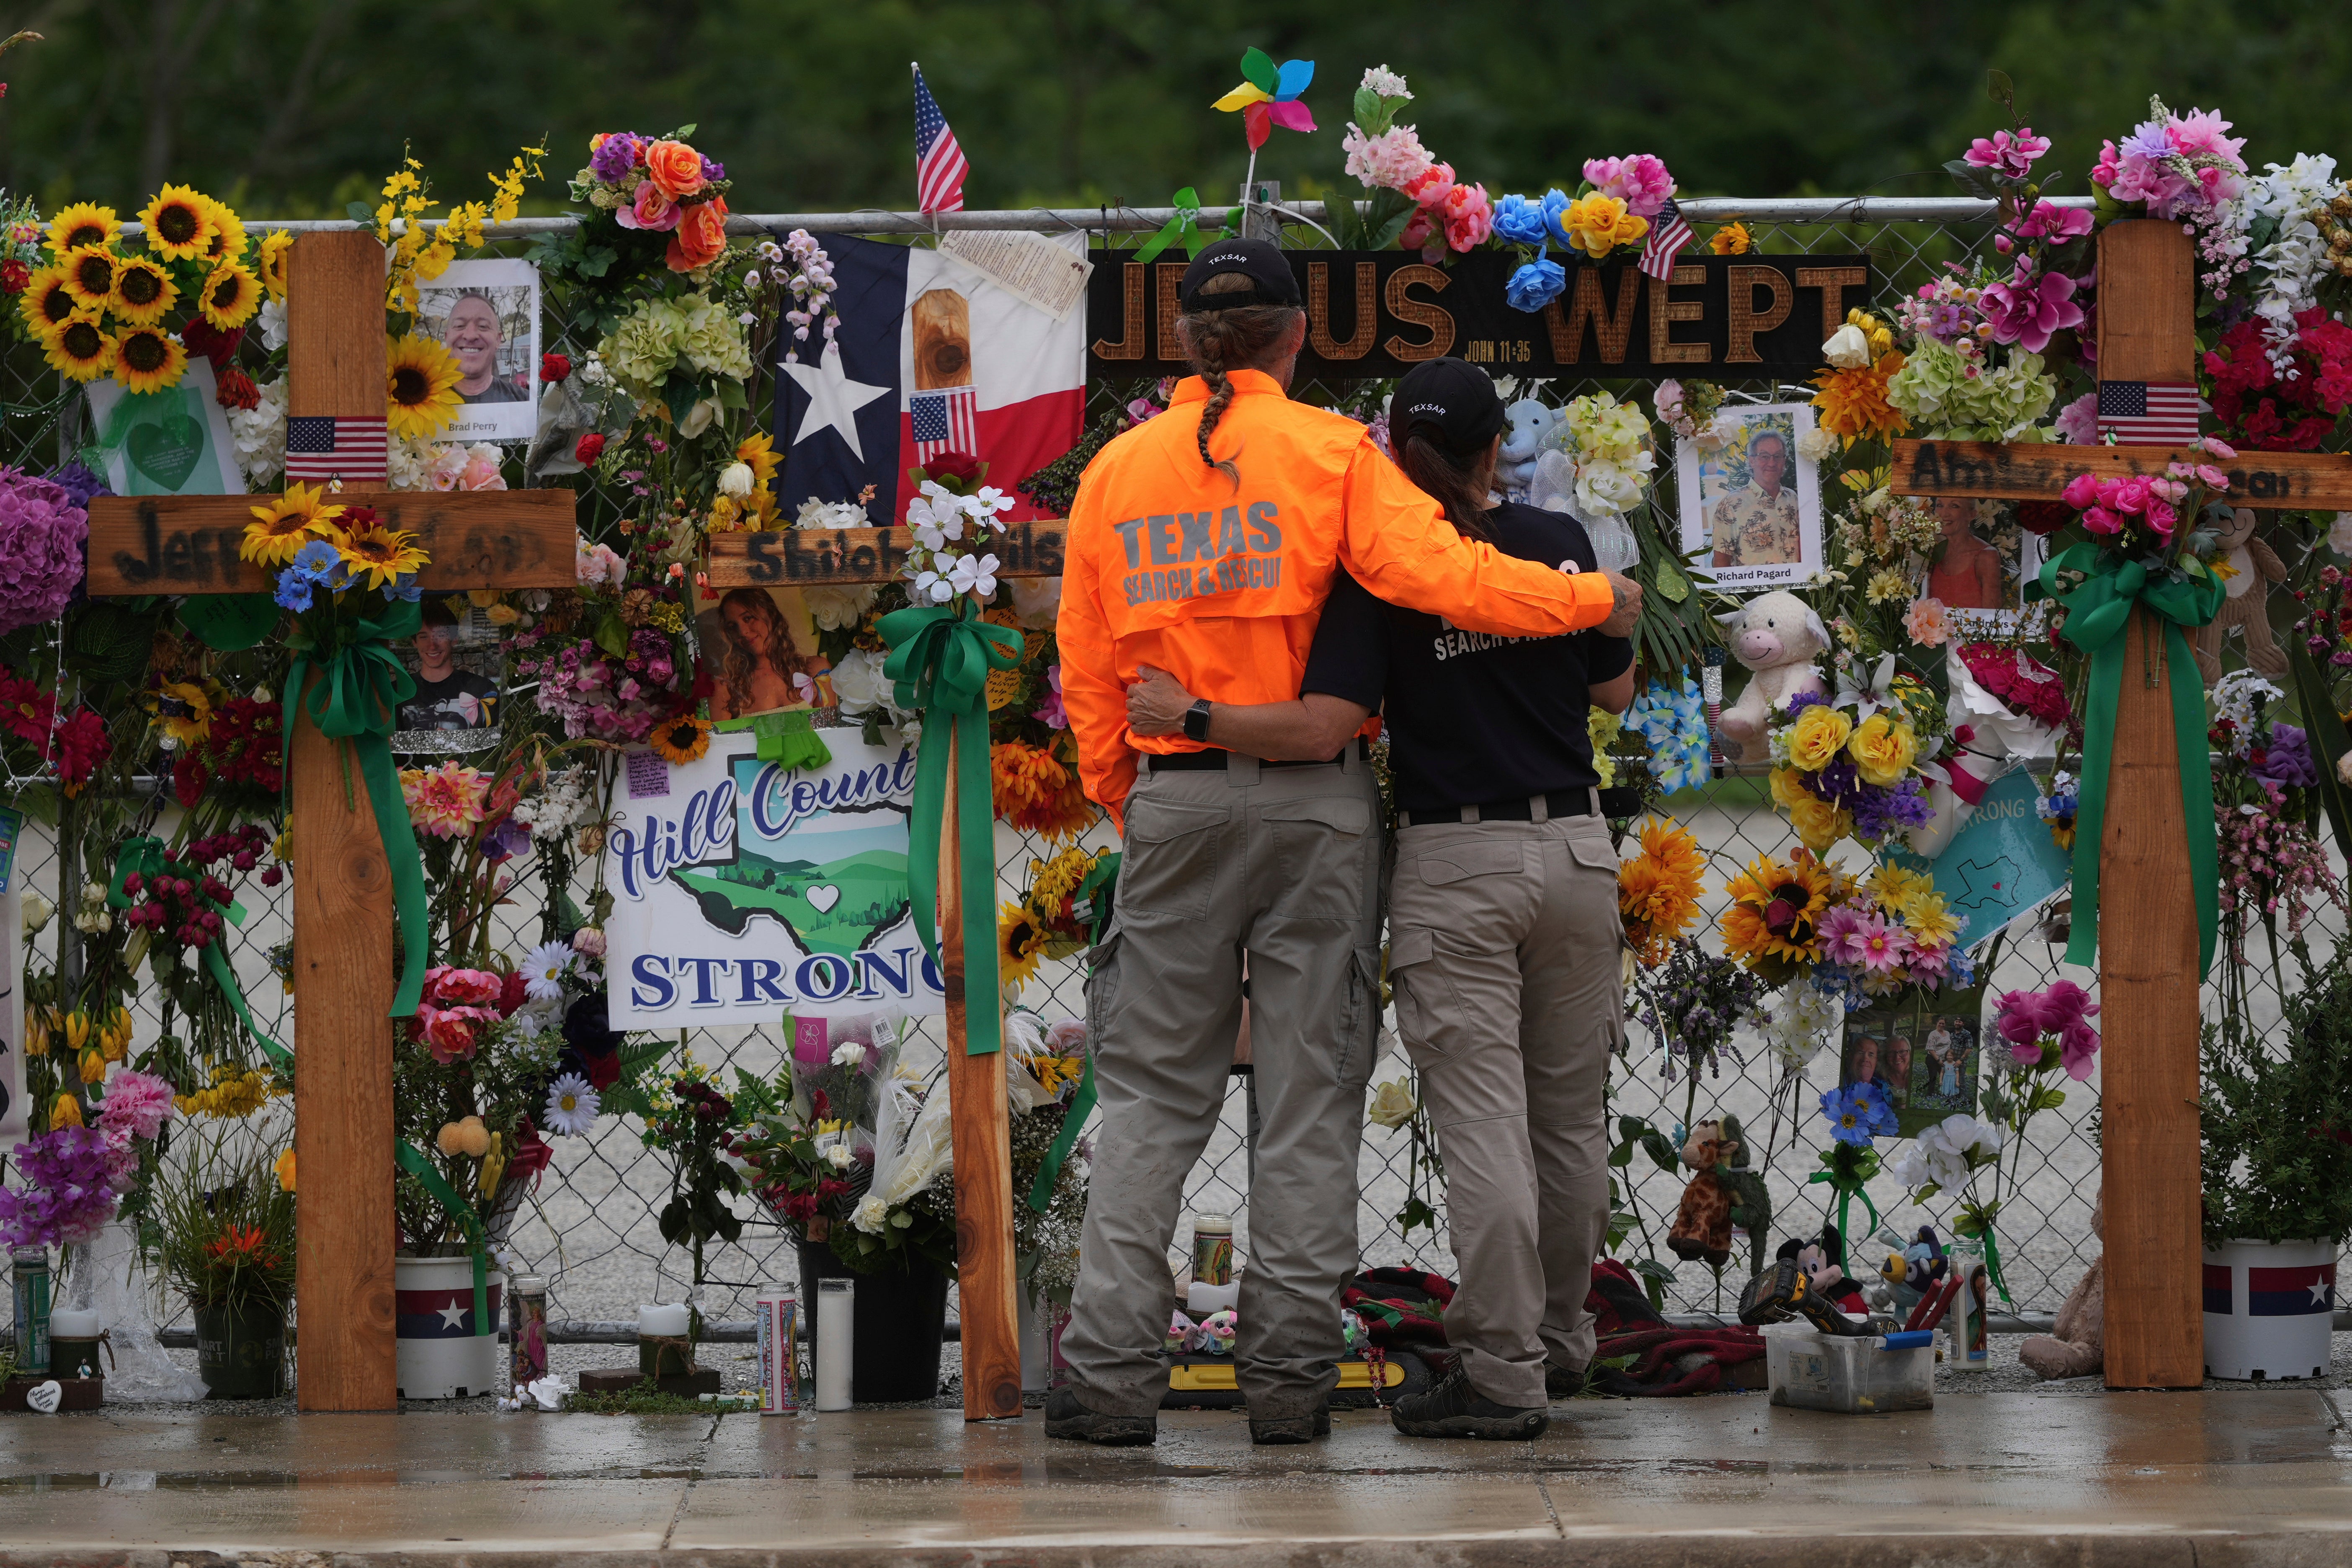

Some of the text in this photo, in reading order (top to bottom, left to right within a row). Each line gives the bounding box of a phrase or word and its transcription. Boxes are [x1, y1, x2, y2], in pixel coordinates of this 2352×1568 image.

[1208, 253, 1247, 266] TEXSAR
[1091, 261, 1456, 363] JEUS
[1544, 264, 1867, 364] WEPT
[1465, 340, 1531, 362] JOHN 11:35
[1409, 402, 1446, 416] TEXSAR
[449, 422, 498, 431] Brad Perry
[1114, 501, 1282, 570] TEXAS
[1717, 568, 1791, 581] Richard Pagard
[1123, 567, 1194, 607] SEARCH
[1198, 567, 1217, 595] &
[1965, 619, 2009, 628] Andres
[1434, 631, 1503, 661] SEARCH
[988, 687, 1007, 696] help
[610, 749, 916, 897] Hill Count
[198, 1338, 222, 1351] MART
